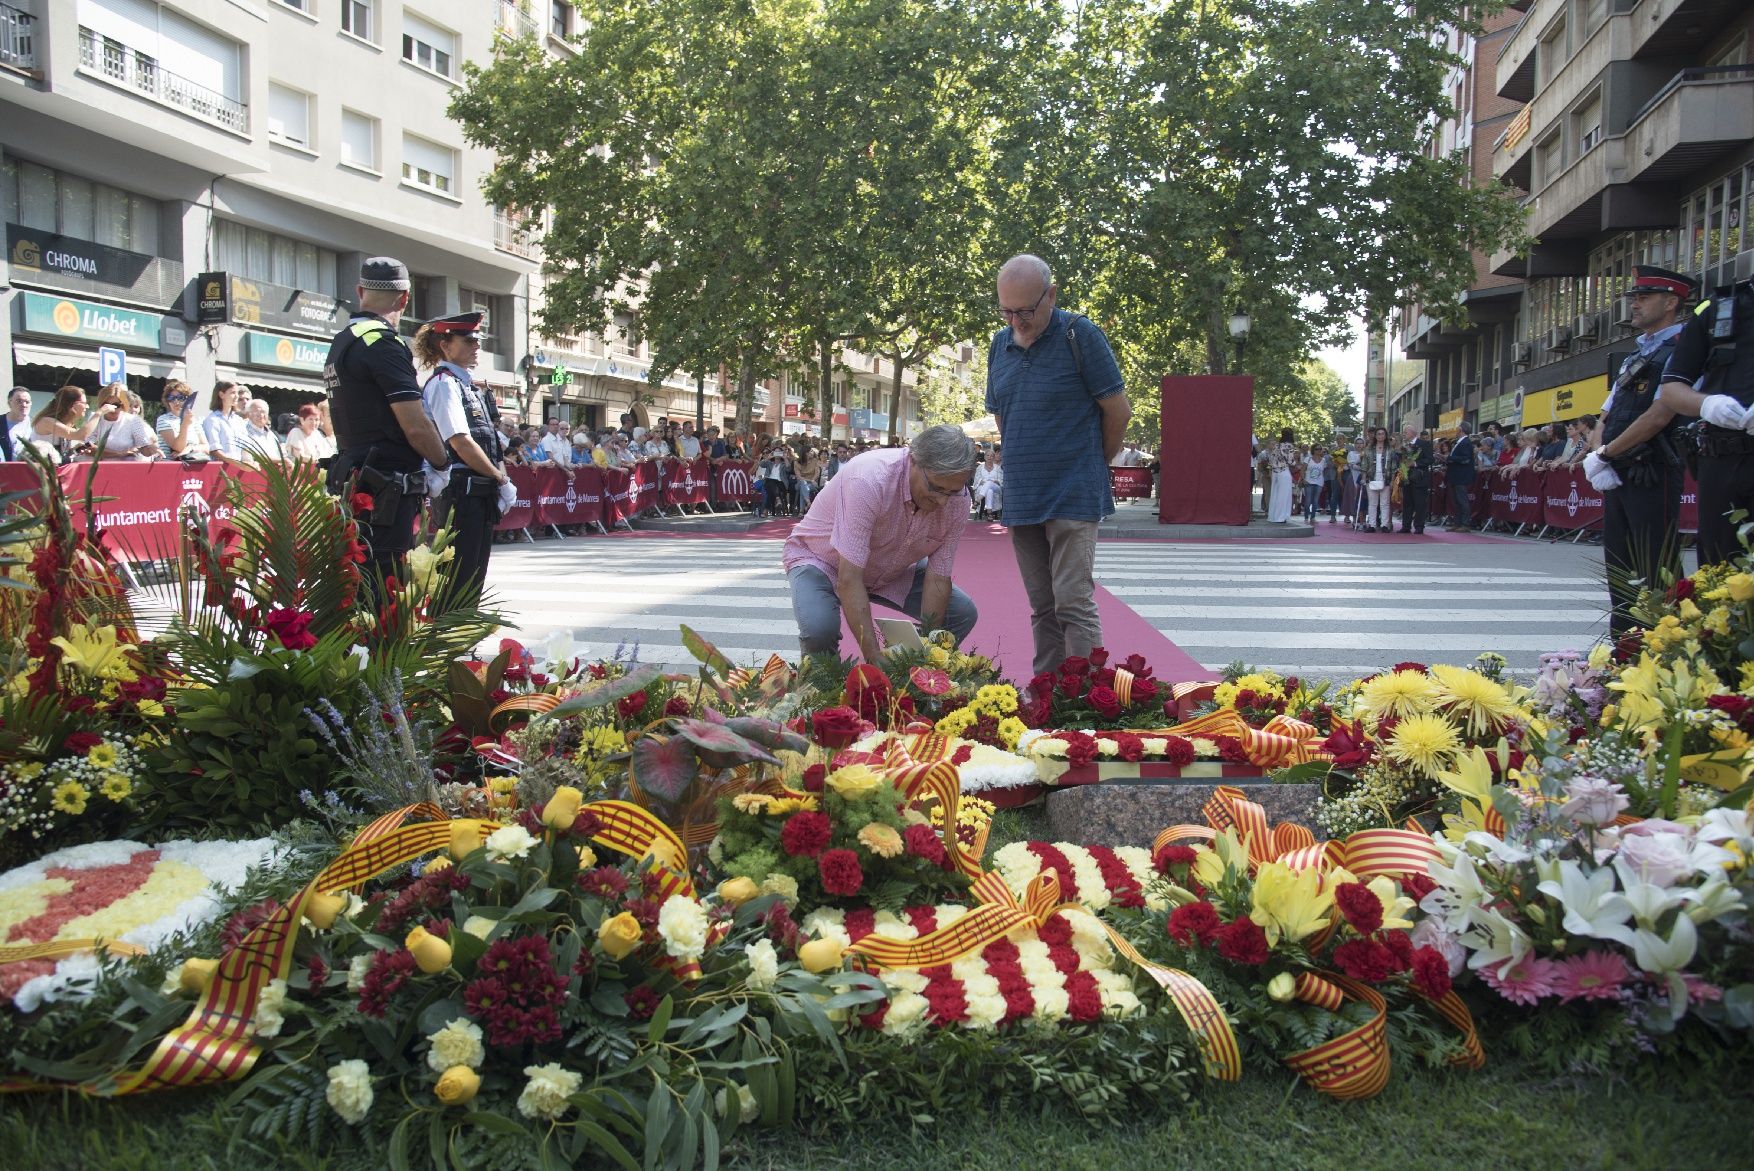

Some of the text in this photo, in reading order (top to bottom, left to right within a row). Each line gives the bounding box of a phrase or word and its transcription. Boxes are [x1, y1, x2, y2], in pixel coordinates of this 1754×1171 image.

[46, 250, 98, 275] CHROMA
[200, 300, 225, 310] CHROMA
[83, 309, 137, 336] Llobet
[295, 345, 327, 364] Llobe
[104, 352, 121, 383] P
[537, 495, 566, 507] Ajuntament
[86, 507, 171, 531] juntament
